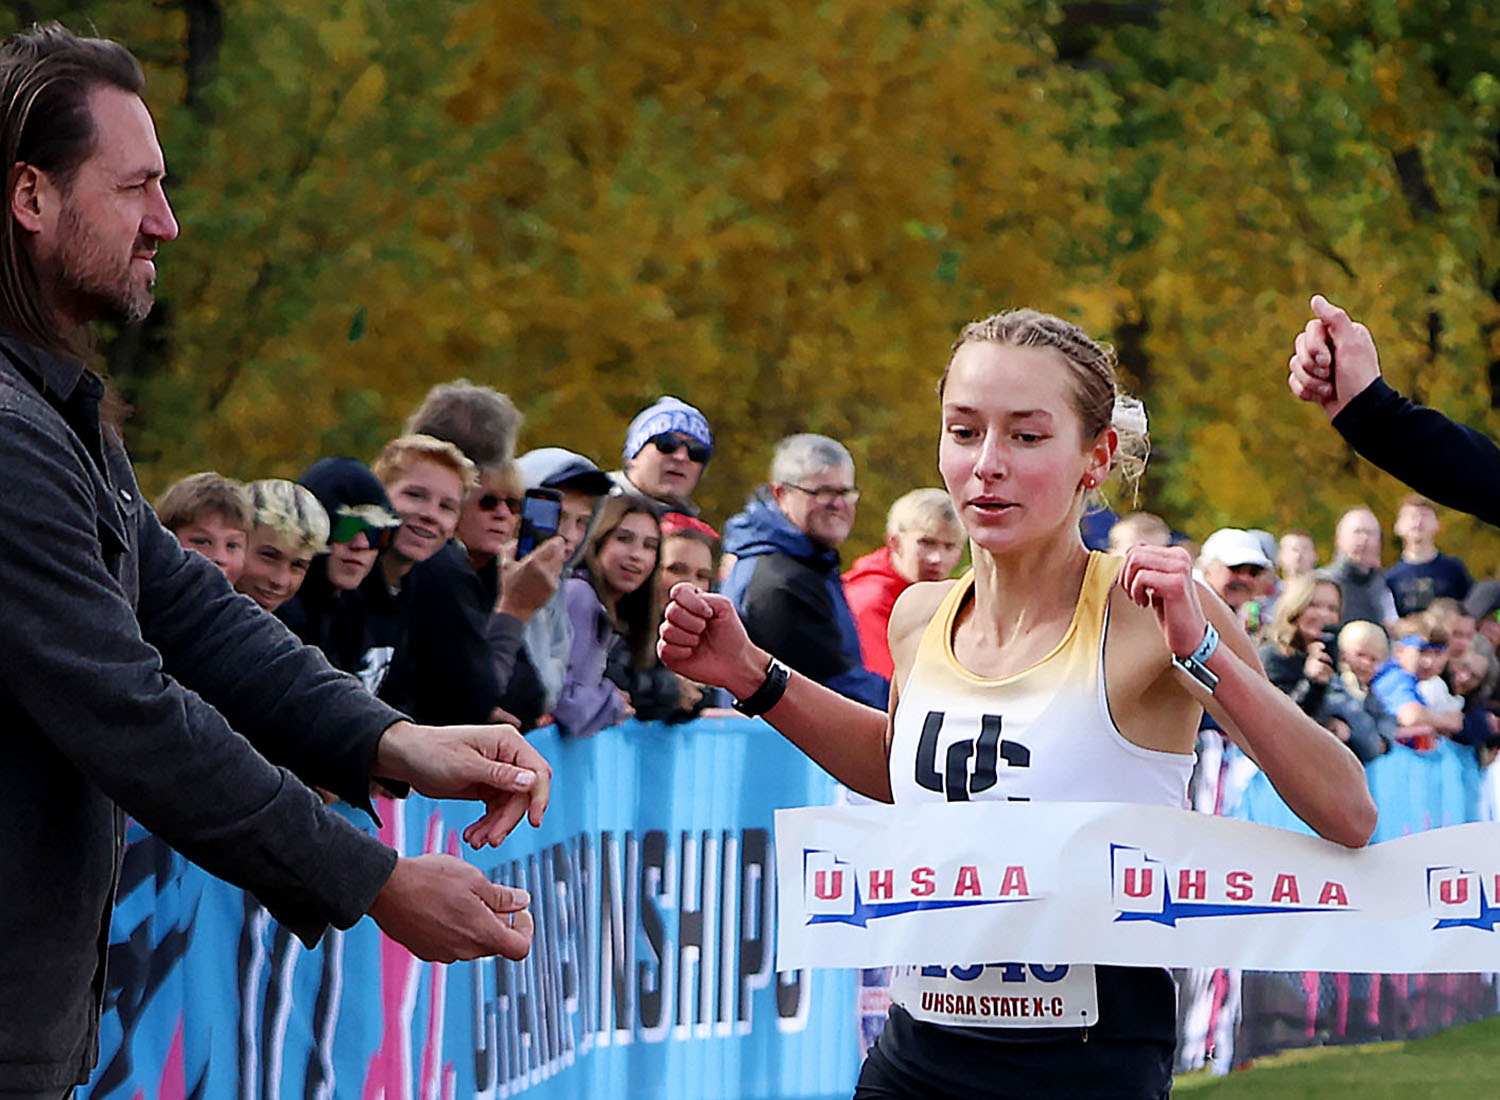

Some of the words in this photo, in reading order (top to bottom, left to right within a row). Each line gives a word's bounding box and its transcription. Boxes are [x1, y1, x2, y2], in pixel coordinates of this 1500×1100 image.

[915, 710, 1031, 801] UC
[814, 866, 1030, 901] UHSAA
[1123, 867, 1351, 906] UHSAA
[920, 991, 977, 1016] UHSAA
[980, 995, 1030, 1017] STATE
[1033, 996, 1065, 1018] X-C
